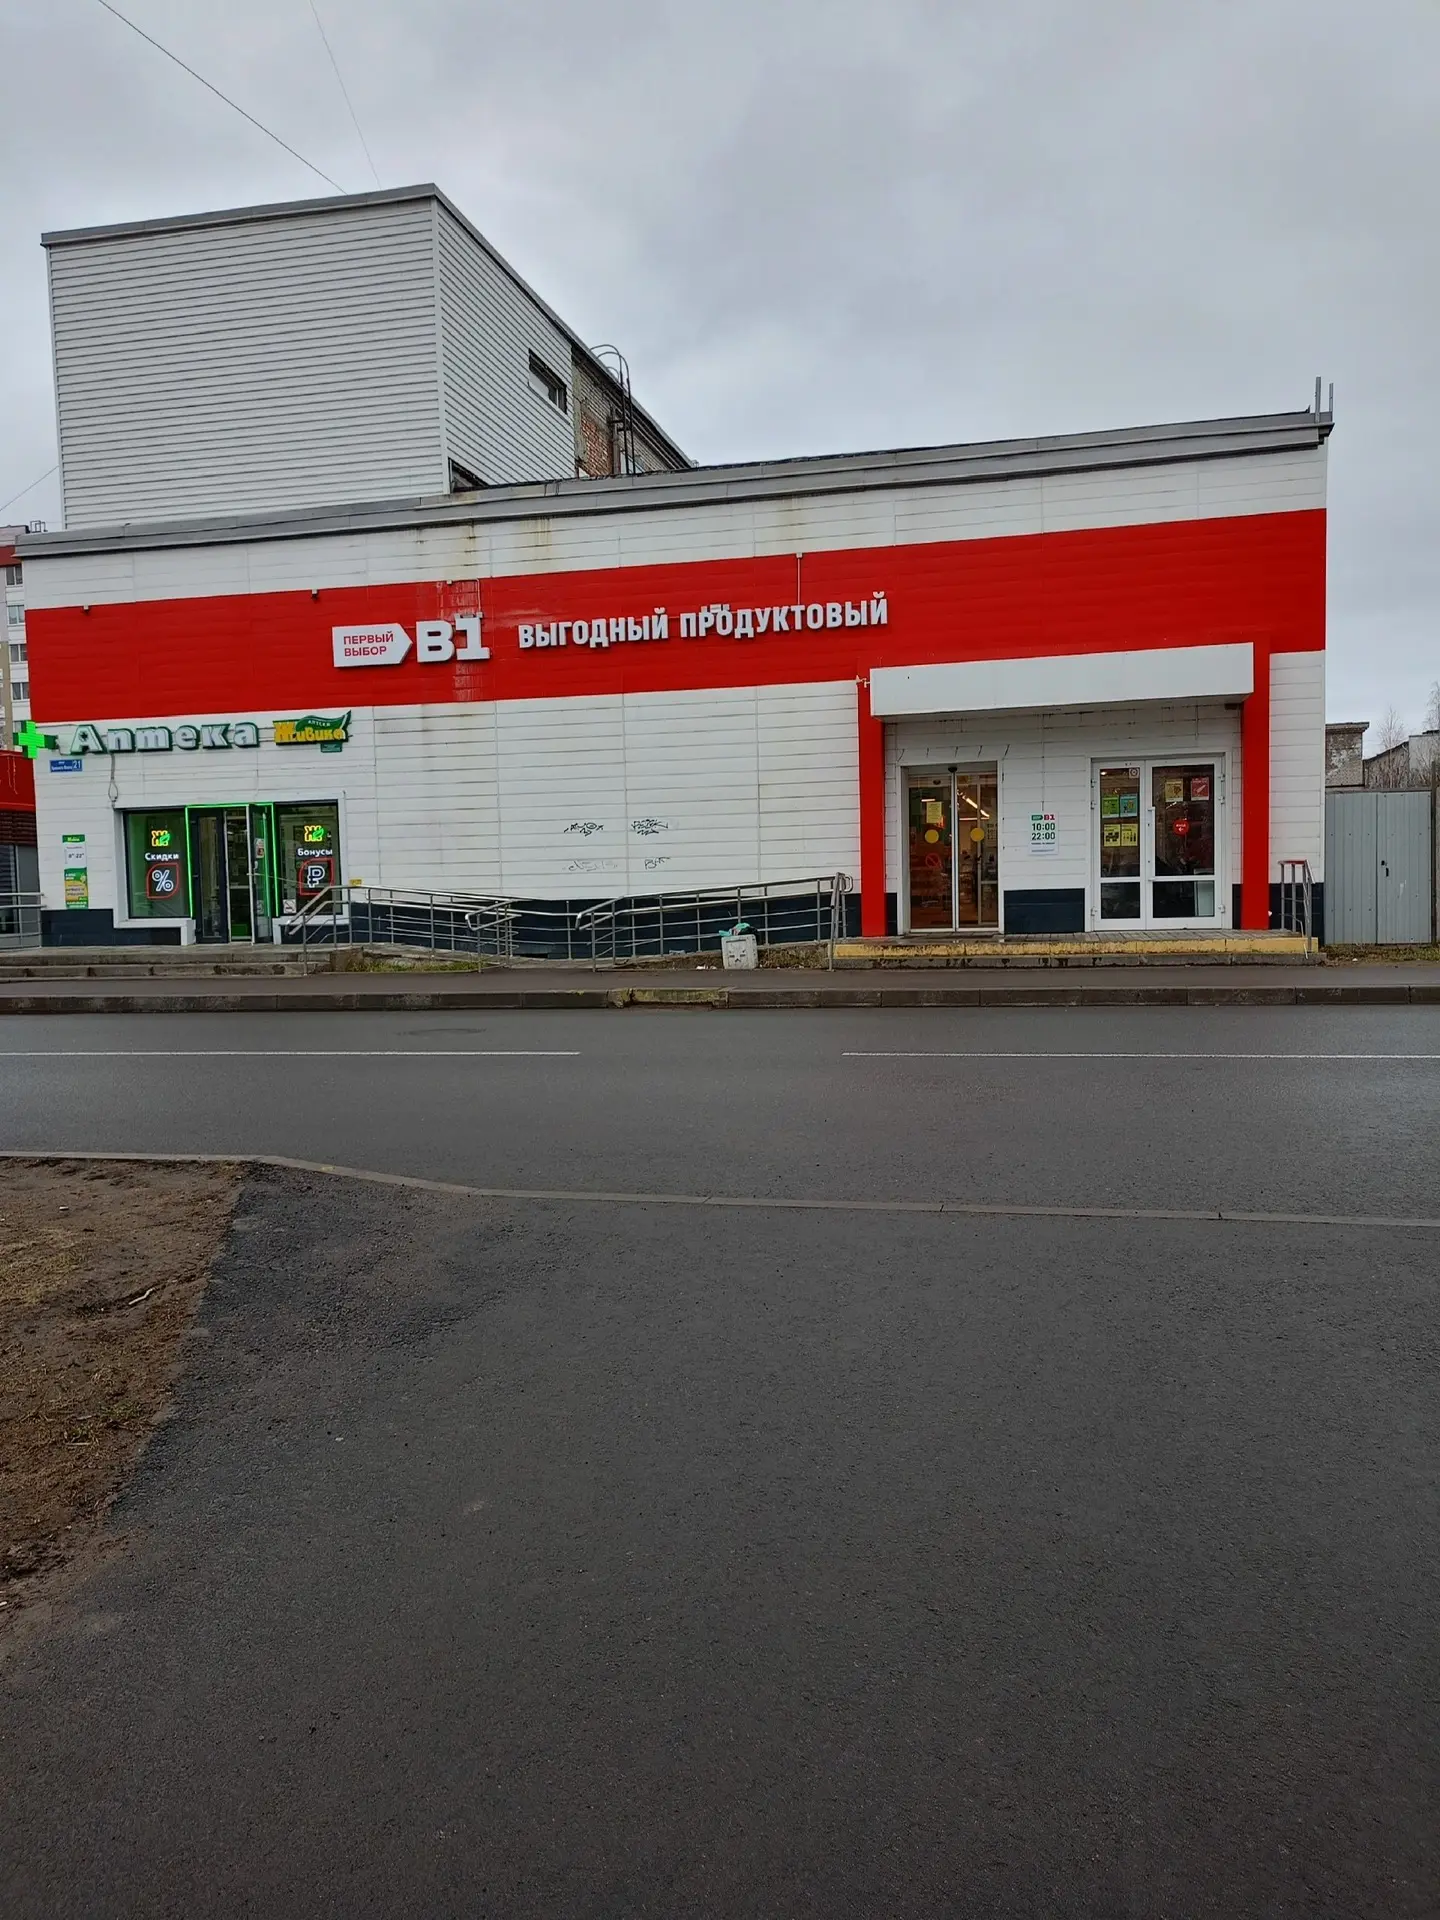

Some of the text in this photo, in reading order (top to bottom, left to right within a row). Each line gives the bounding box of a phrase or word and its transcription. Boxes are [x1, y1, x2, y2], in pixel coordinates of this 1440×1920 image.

[518, 591, 888, 648] ВЫГОДНЫЙ ПРОДУКТОВЫЙ
[343, 631, 394, 645] ПЕРВЫЙ
[344, 646, 387, 657] ВЫБОР
[70, 722, 259, 754] Аптека
[73, 760, 81, 769] 21
[1032, 822, 1056, 831] 10:00
[1031, 832, 1056, 841] 22:00
[145, 852, 180, 862] Скидки
[297, 848, 333, 857] Бонусы
